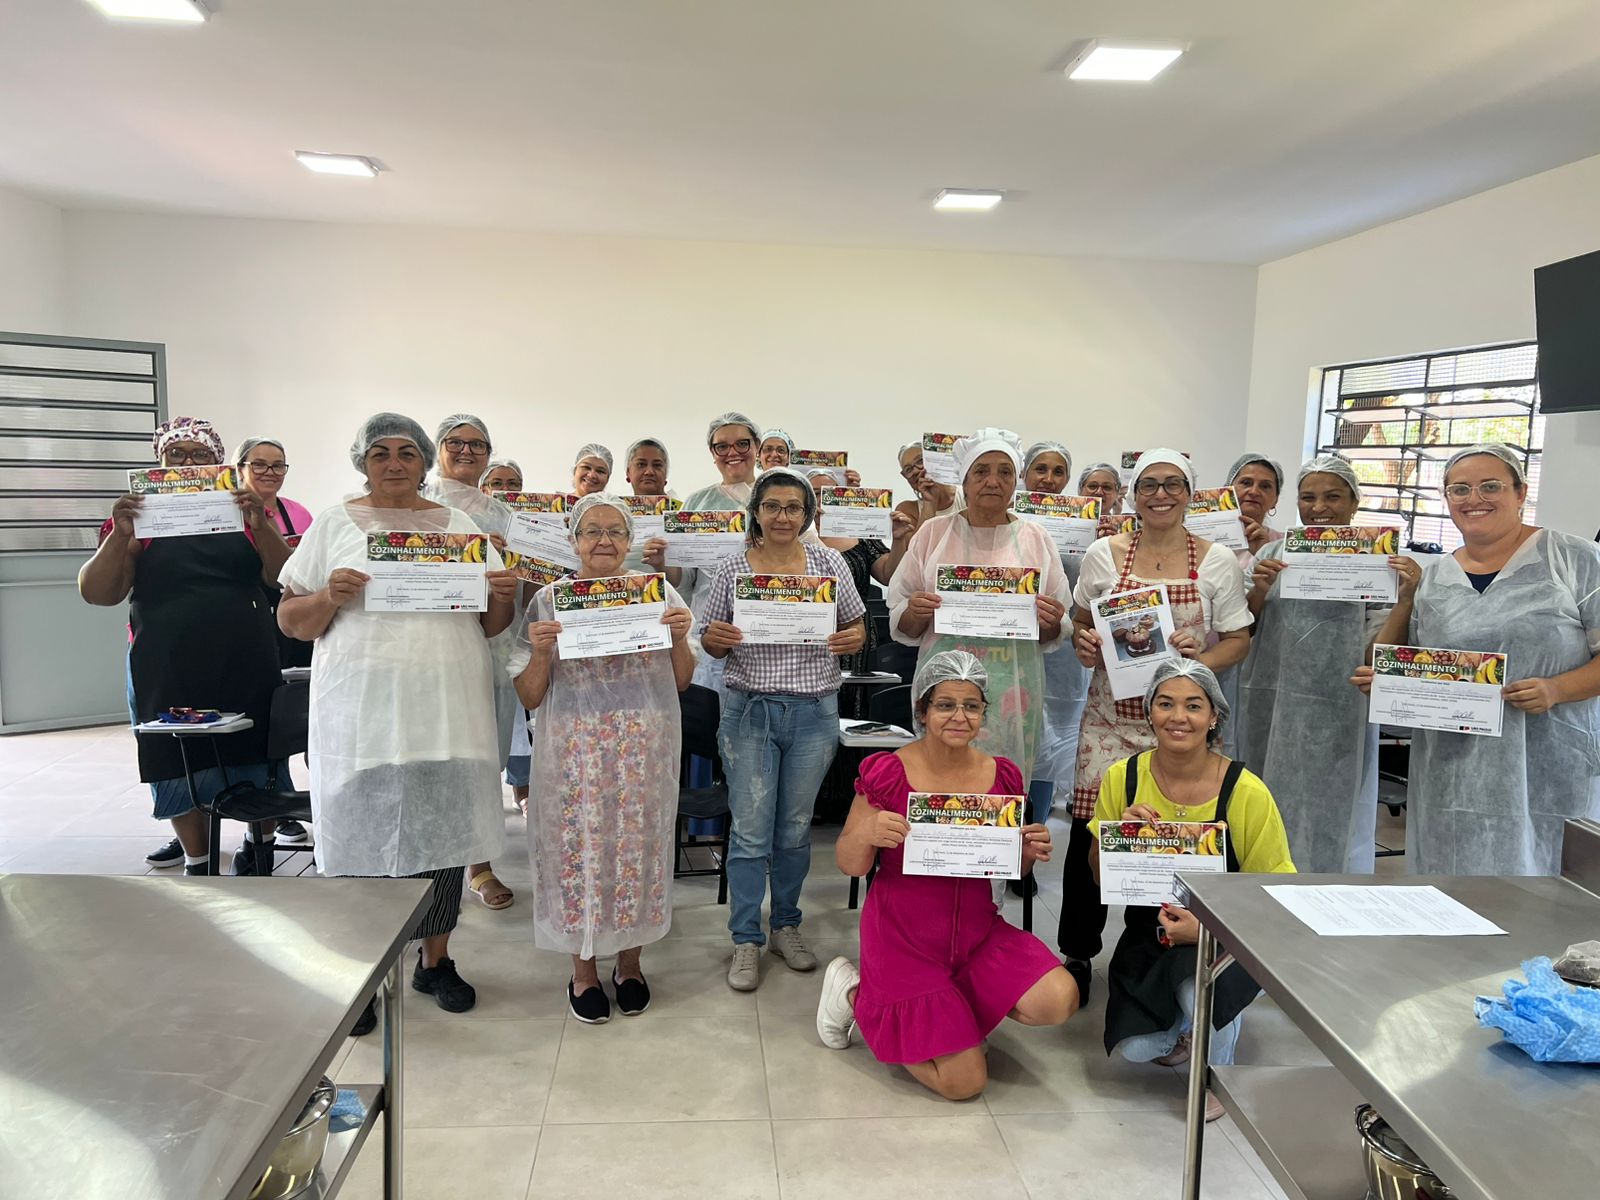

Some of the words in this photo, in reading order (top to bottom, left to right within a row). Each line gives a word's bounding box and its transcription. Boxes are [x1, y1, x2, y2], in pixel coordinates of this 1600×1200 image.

[133, 479, 201, 490] COZINHALIMENTO
[823, 495, 868, 503] COZINHALIMENTO
[1016, 502, 1070, 512] COZINHALIMENTO
[1287, 539, 1358, 547] COZINHALIMENTO
[370, 546, 446, 555] COZINHALIMENTO
[939, 578, 1004, 587] COZINHALIMENTO
[738, 587, 801, 596] COZINHALIMENTO
[557, 591, 628, 604] COZINHALIMENTO
[1377, 660, 1457, 673] COZINHALIMENTO
[910, 808, 983, 818] COZINHALIMENTO
[1103, 837, 1180, 847] COZINHALIMENTO
